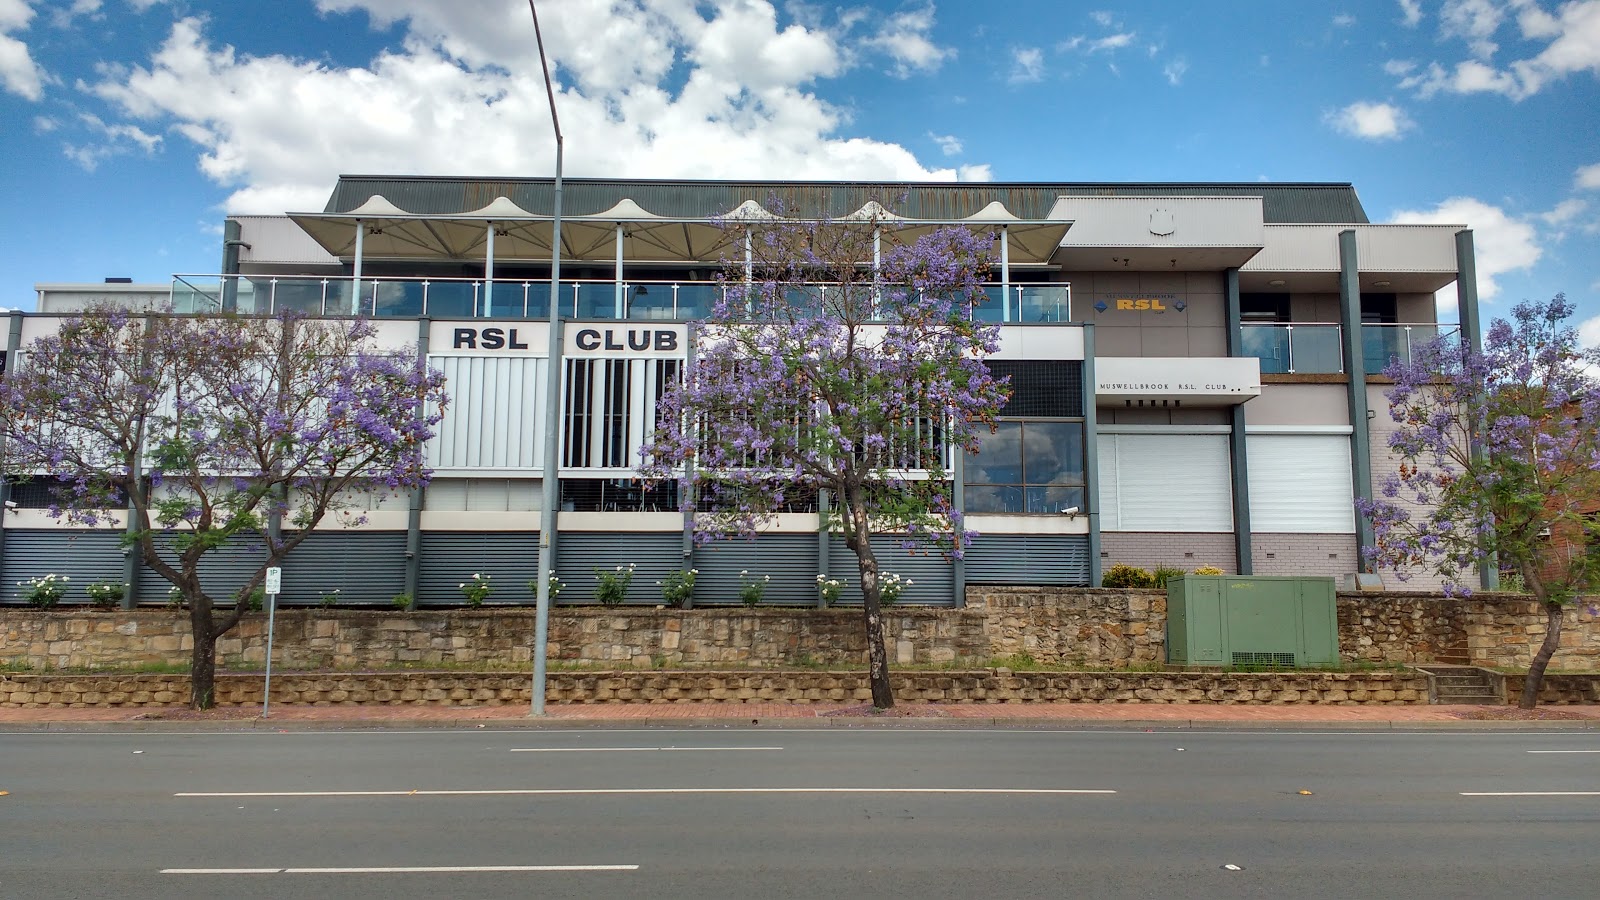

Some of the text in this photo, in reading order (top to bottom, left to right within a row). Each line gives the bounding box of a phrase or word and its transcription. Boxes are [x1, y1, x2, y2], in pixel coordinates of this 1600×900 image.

[1116, 299, 1166, 310] RSL
[453, 328, 678, 351] RSL CLUB
